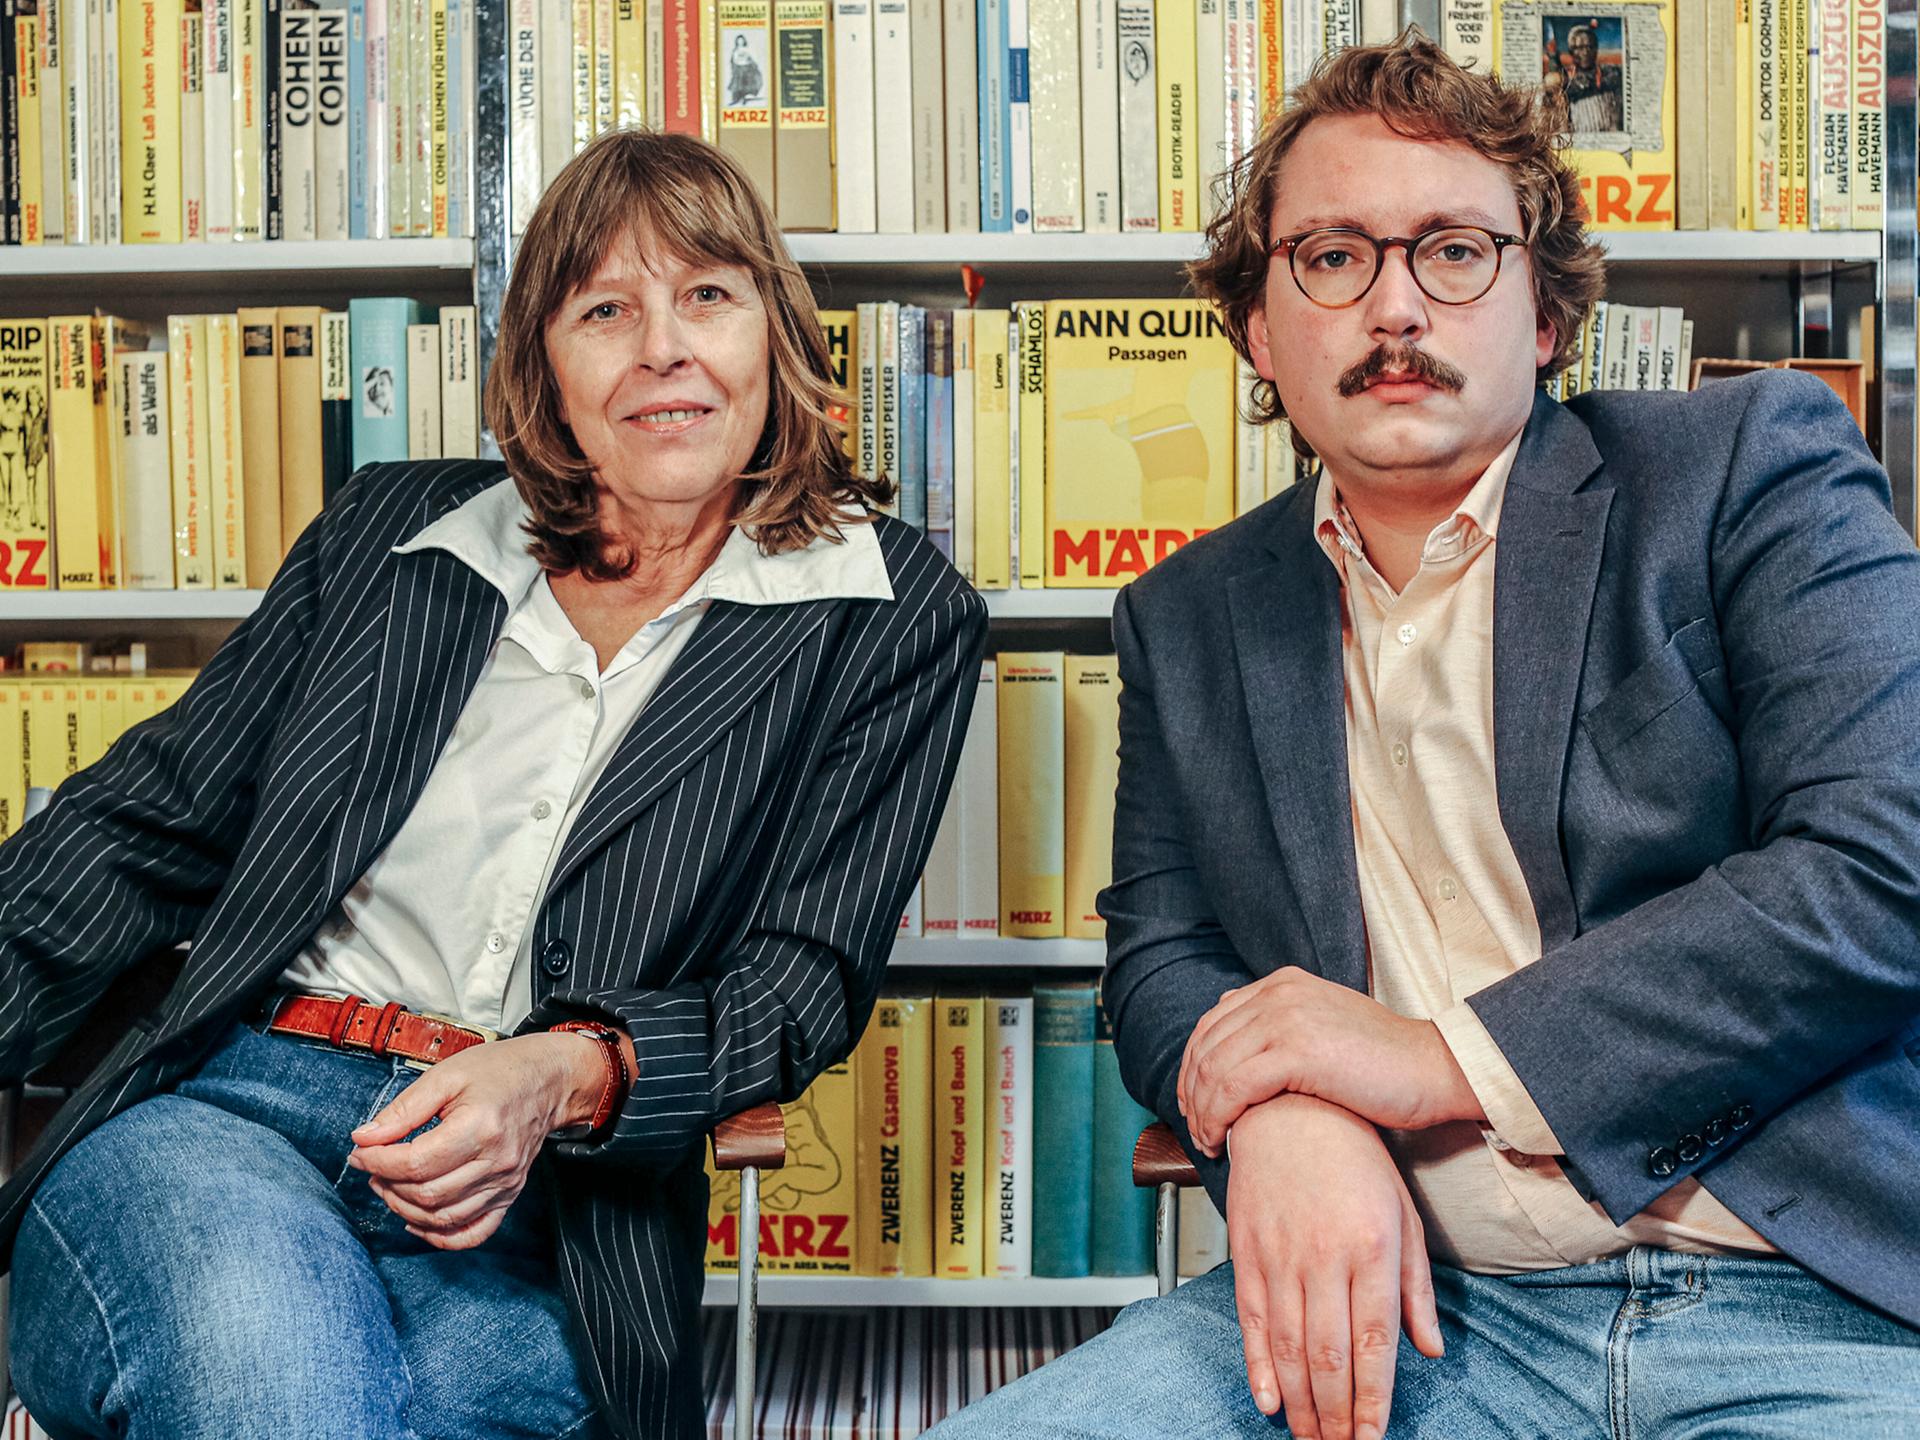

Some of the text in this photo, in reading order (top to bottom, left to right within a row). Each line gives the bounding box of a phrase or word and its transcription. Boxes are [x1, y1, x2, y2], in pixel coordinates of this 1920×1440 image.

[141, 1, 156, 57] Kumpel
[217, 11, 228, 73] Blumen für
[1339, 19, 1350, 31] M.
[1456, 23, 1483, 32] ODER
[1460, 35, 1480, 43] TOD
[49, 49, 57, 67] Das
[205, 23, 216, 74] Leonard
[519, 31, 533, 62] DER
[676, 10, 689, 118] Gestaltpädagogik in
[285, 17, 311, 127] COHEN
[319, 17, 343, 125] COHEN
[1779, 52, 1788, 84] MACHT
[1796, 52, 1805, 84] MACHT
[244, 89, 252, 127] Leonard
[1760, 62, 1772, 121] DOKTOR
[1779, 87, 1788, 103] DIE
[1796, 87, 1805, 103] DIE
[143, 115, 155, 140] Laß
[433, 11, 446, 232] MÄRZ COHEN BLUMEN FÜR HITLER
[723, 110, 768, 123] MÄRZ
[781, 110, 825, 123] MÄRZ
[1779, 105, 1788, 141] KINDER
[1796, 105, 1805, 141] KINDER
[1171, 83, 1183, 226] MÄRZ EROTIK-READER
[1780, 143, 1789, 159] DIE
[1796, 143, 1805, 159] DIE
[1825, 113, 1835, 174] FLORIAN
[1837, 113, 1848, 194] HAVEMANN
[1858, 112, 1868, 173] FLORIAN
[1871, 112, 1882, 192] HAVEMANN
[143, 147, 155, 180] Claer
[1780, 161, 1789, 177] ALS
[1796, 161, 1805, 177] ALS
[144, 184, 156, 198] H.
[144, 202, 156, 215] H.
[1779, 187, 1789, 224] MÄRZ
[1796, 187, 1806, 224] MÄRZ
[26, 204, 37, 241] MÄRZ
[1054, 310, 1227, 338] ANN QUIN
[1590, 310, 1603, 367] einer Ehe
[1621, 314, 1630, 359] einer Ehe
[71, 324, 85, 389] als Waffe
[327, 320, 336, 387] Die albanische
[1028, 310, 1042, 394] SCHAMLOS
[1108, 346, 1188, 362] Passagen
[18, 369, 42, 378] John
[994, 354, 1003, 389] Lernen
[122, 364, 131, 417] Münzenberg
[141, 363, 158, 435] als Waffe
[861, 367, 874, 472] HORST PEISKER
[882, 366, 895, 472] HORST PEISKER
[62, 573, 94, 583] MÄRZ
[22, 710, 30, 760] ERGRIFFEN
[67, 712, 77, 752] HITLER
[926, 919, 958, 930] MÄRZ
[964, 919, 997, 929] MÄRZ
[1010, 911, 1052, 924] MÄRZ
[880, 1046, 899, 1137] Casanova
[950, 1046, 966, 1245] ZWERENZ Kopf und Bauch
[1001, 1046, 1015, 1244] ZWERENZ Kopf und Bauch
[881, 1144, 900, 1244] ZWERENZ
